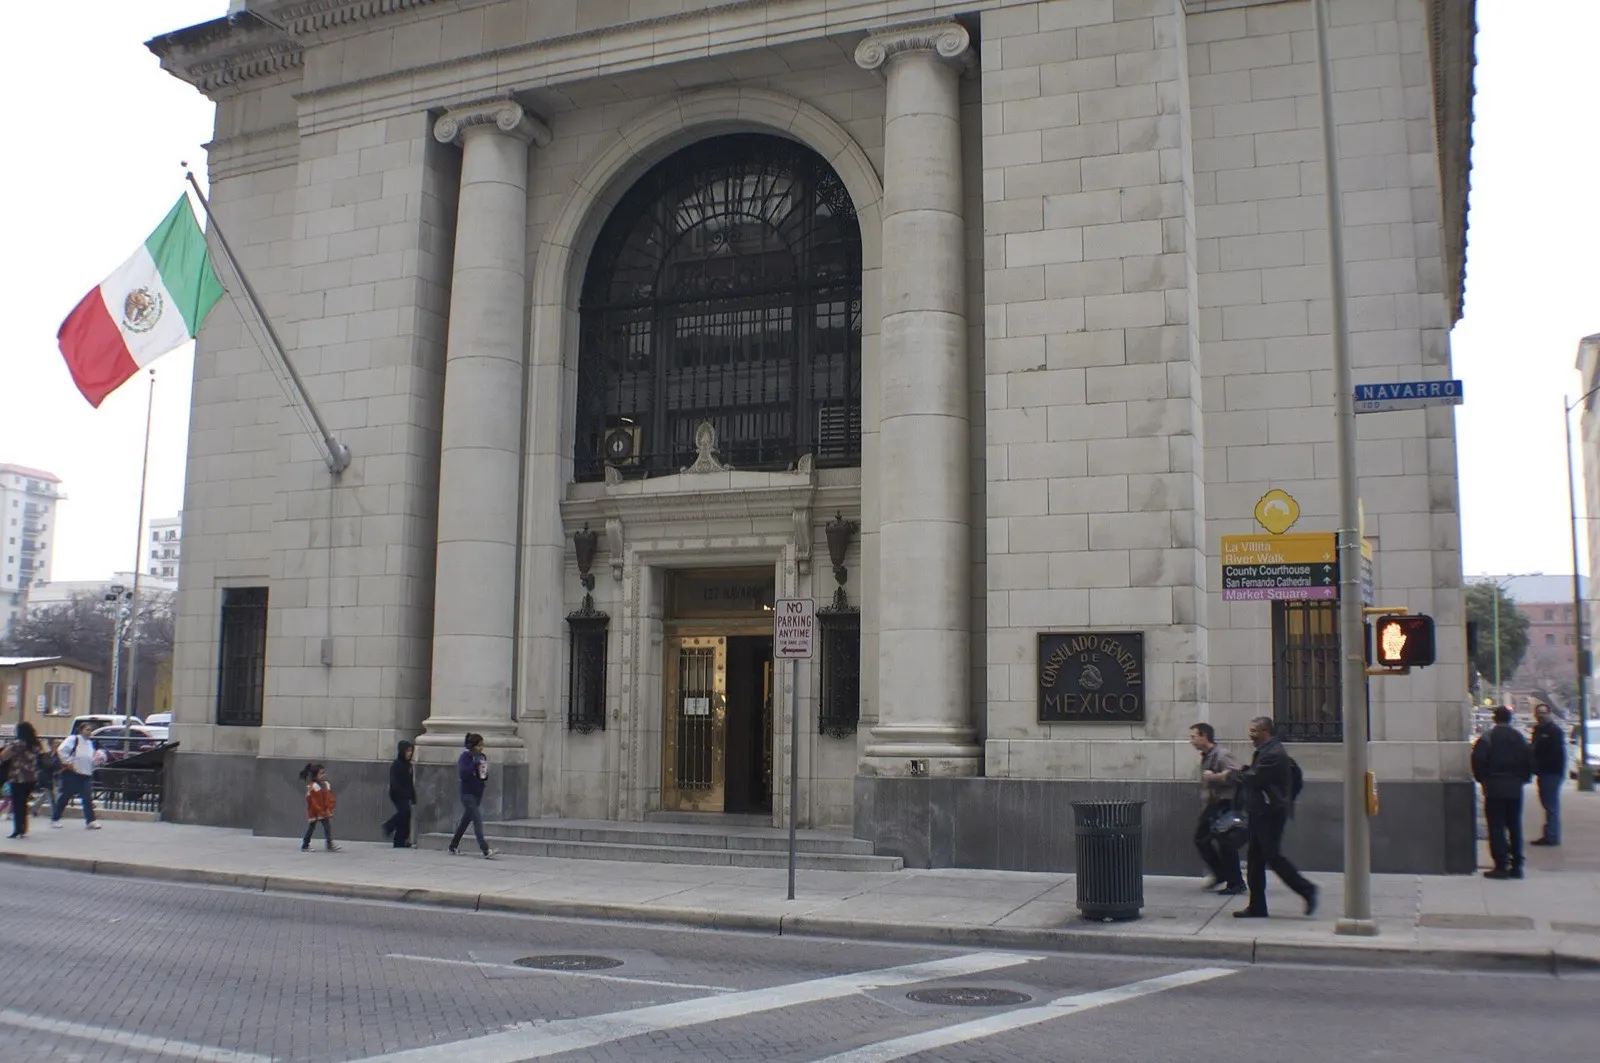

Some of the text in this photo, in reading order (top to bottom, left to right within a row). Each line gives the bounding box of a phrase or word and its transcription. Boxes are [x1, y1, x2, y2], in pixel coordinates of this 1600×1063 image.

[1363, 382, 1455, 399] NAVARRO
[1225, 541, 1271, 552] La Villita
[1225, 553, 1284, 564] River Walk
[1226, 564, 1310, 577] County Courthouse
[1226, 576, 1312, 588] San Fernando Cathedral
[1226, 588, 1308, 600] Market Square
[787, 602, 803, 614] NO
[777, 615, 811, 627] PARKING
[779, 628, 810, 638] ANYTIME
[1040, 635, 1142, 688] CONSULADO GENERAL
[1080, 653, 1100, 662] DE
[1043, 693, 1139, 714] MEXICO
